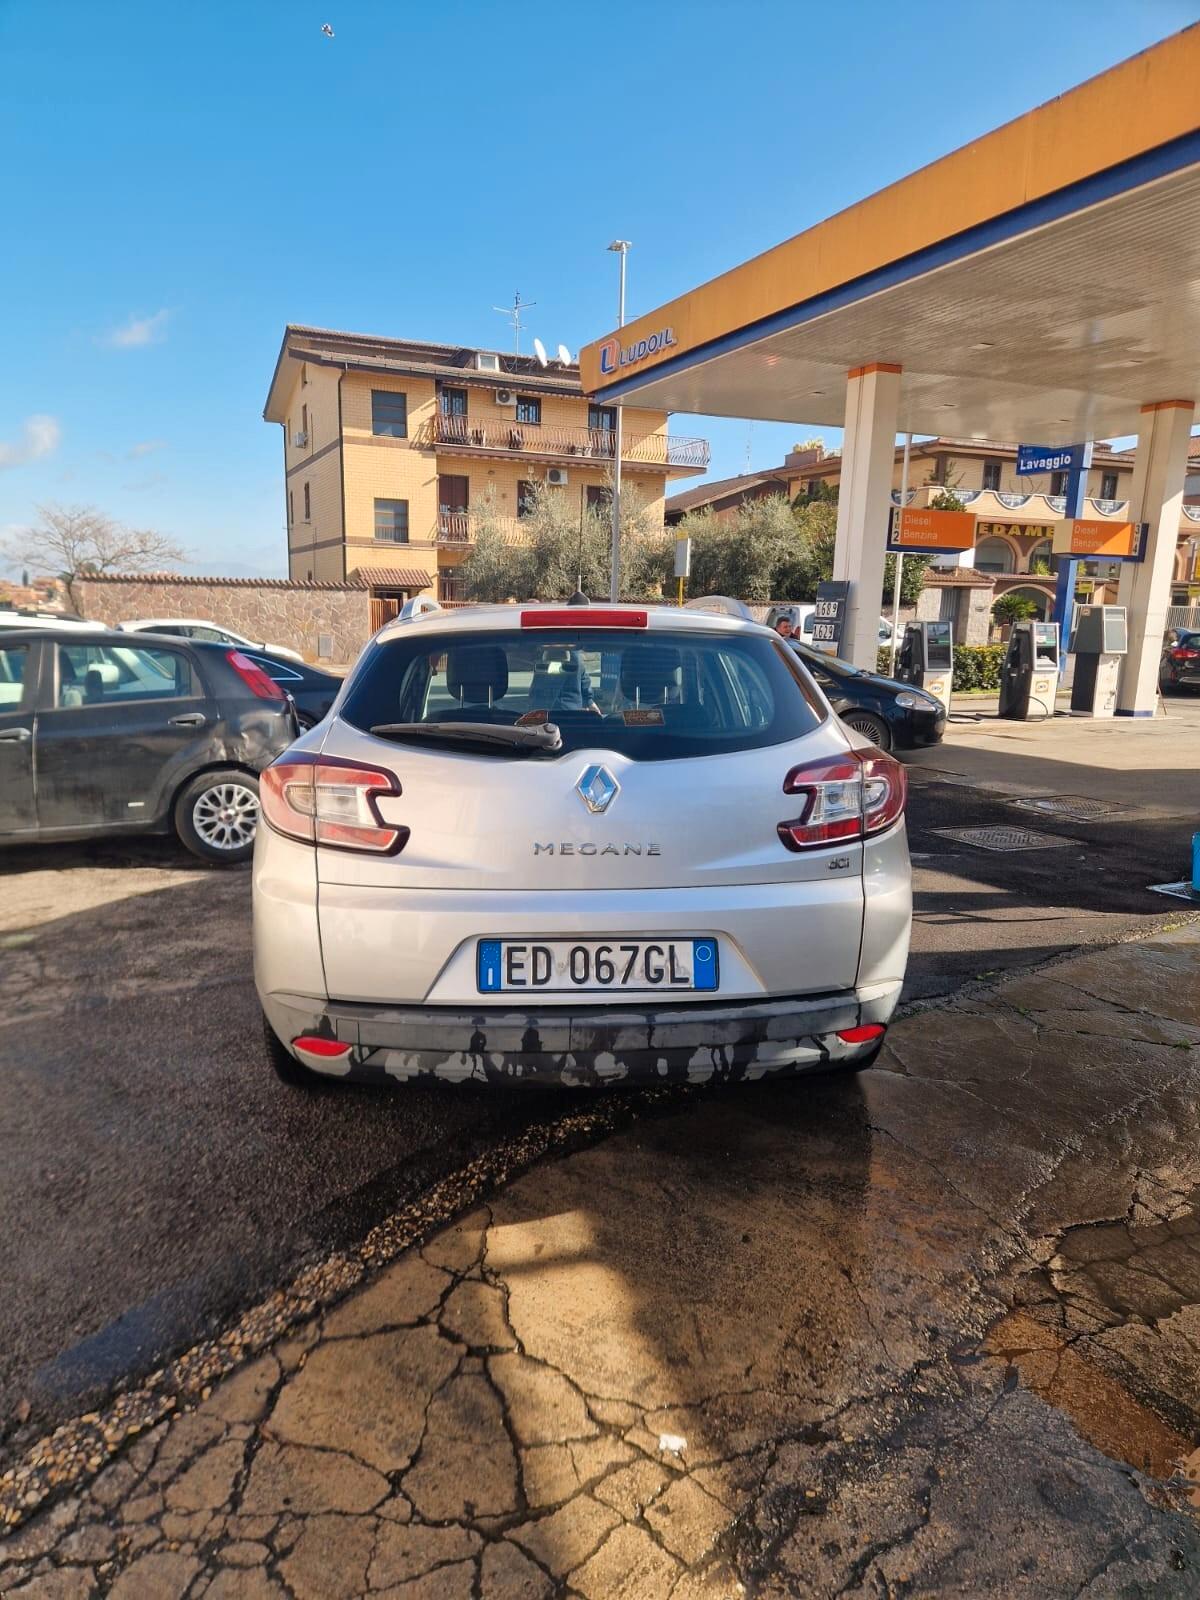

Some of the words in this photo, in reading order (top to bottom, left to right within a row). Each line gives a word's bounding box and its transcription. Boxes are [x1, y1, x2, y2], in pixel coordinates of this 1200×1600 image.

[619, 328, 674, 366] LUDOIL
[1020, 454, 1071, 470] Lavaggio
[904, 514, 932, 527] Diesel
[893, 530, 900, 542] 2
[903, 529, 938, 540] Benzina
[1074, 524, 1098, 536] Diesel
[533, 842, 662, 856] MEGANE
[506, 946, 552, 986] ED
[569, 944, 690, 985] 067GL
